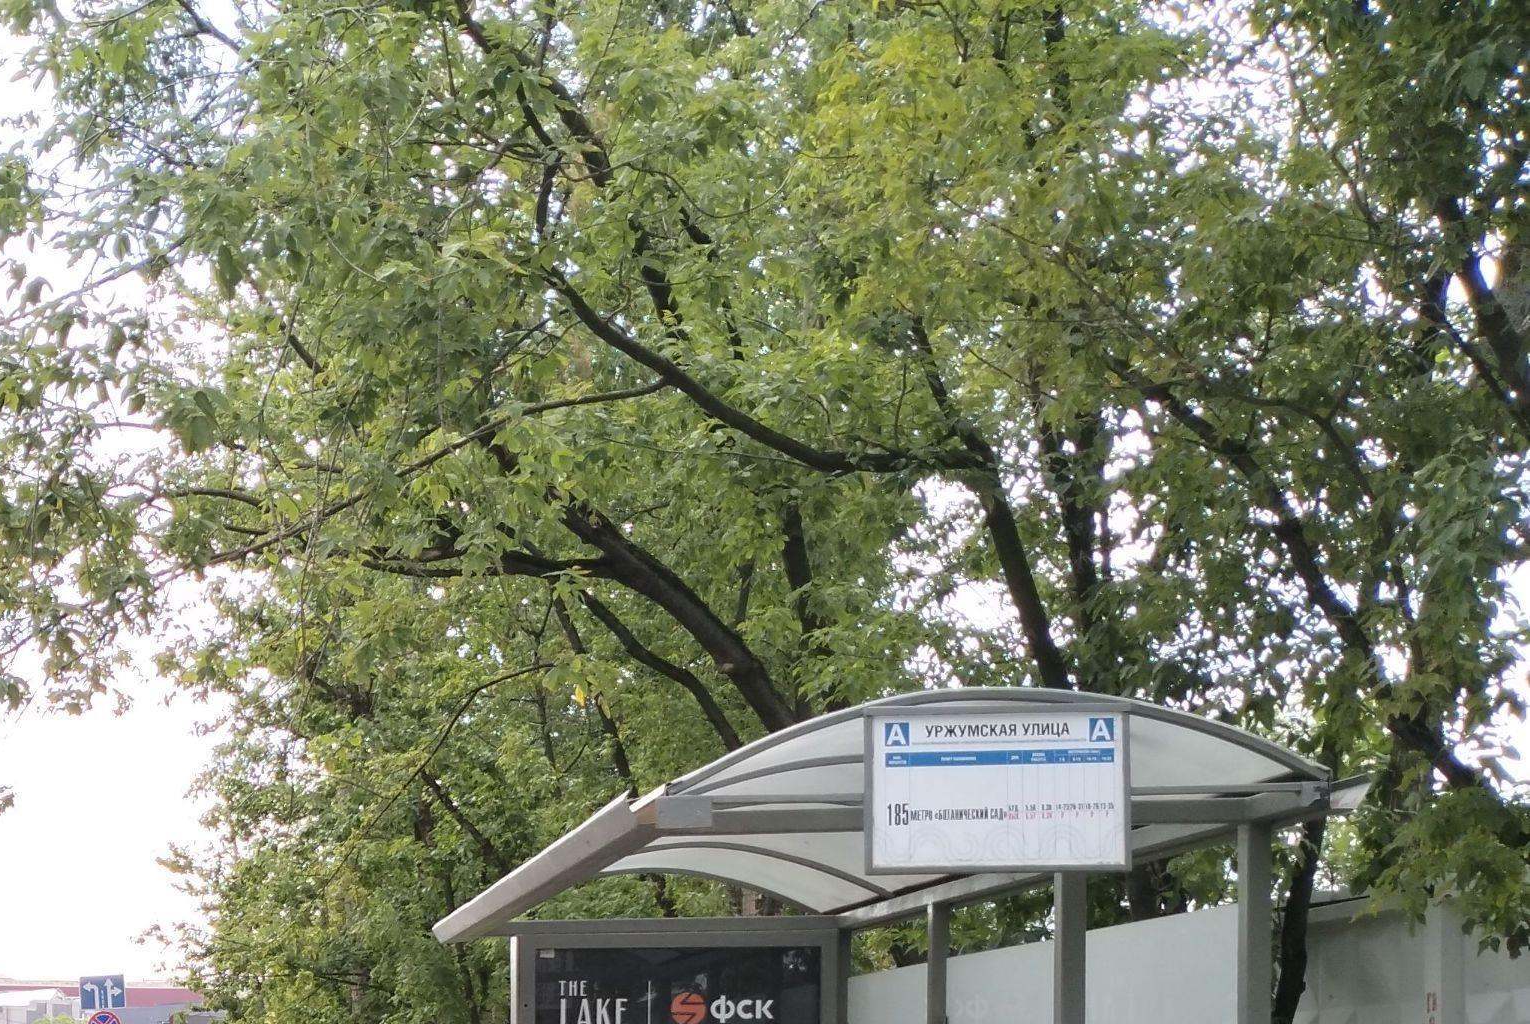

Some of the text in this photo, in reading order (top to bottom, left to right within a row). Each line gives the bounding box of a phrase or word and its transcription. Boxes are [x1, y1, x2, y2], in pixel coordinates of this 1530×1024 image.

[925, 723, 1017, 738] УРЖУМСКАЯ
[1022, 722, 1070, 738] УЛИЦА
[887, 803, 909, 826] 185
[910, 809, 933, 821] МЕТРО
[559, 980, 588, 997] THE
[710, 995, 775, 1024] ФСК
